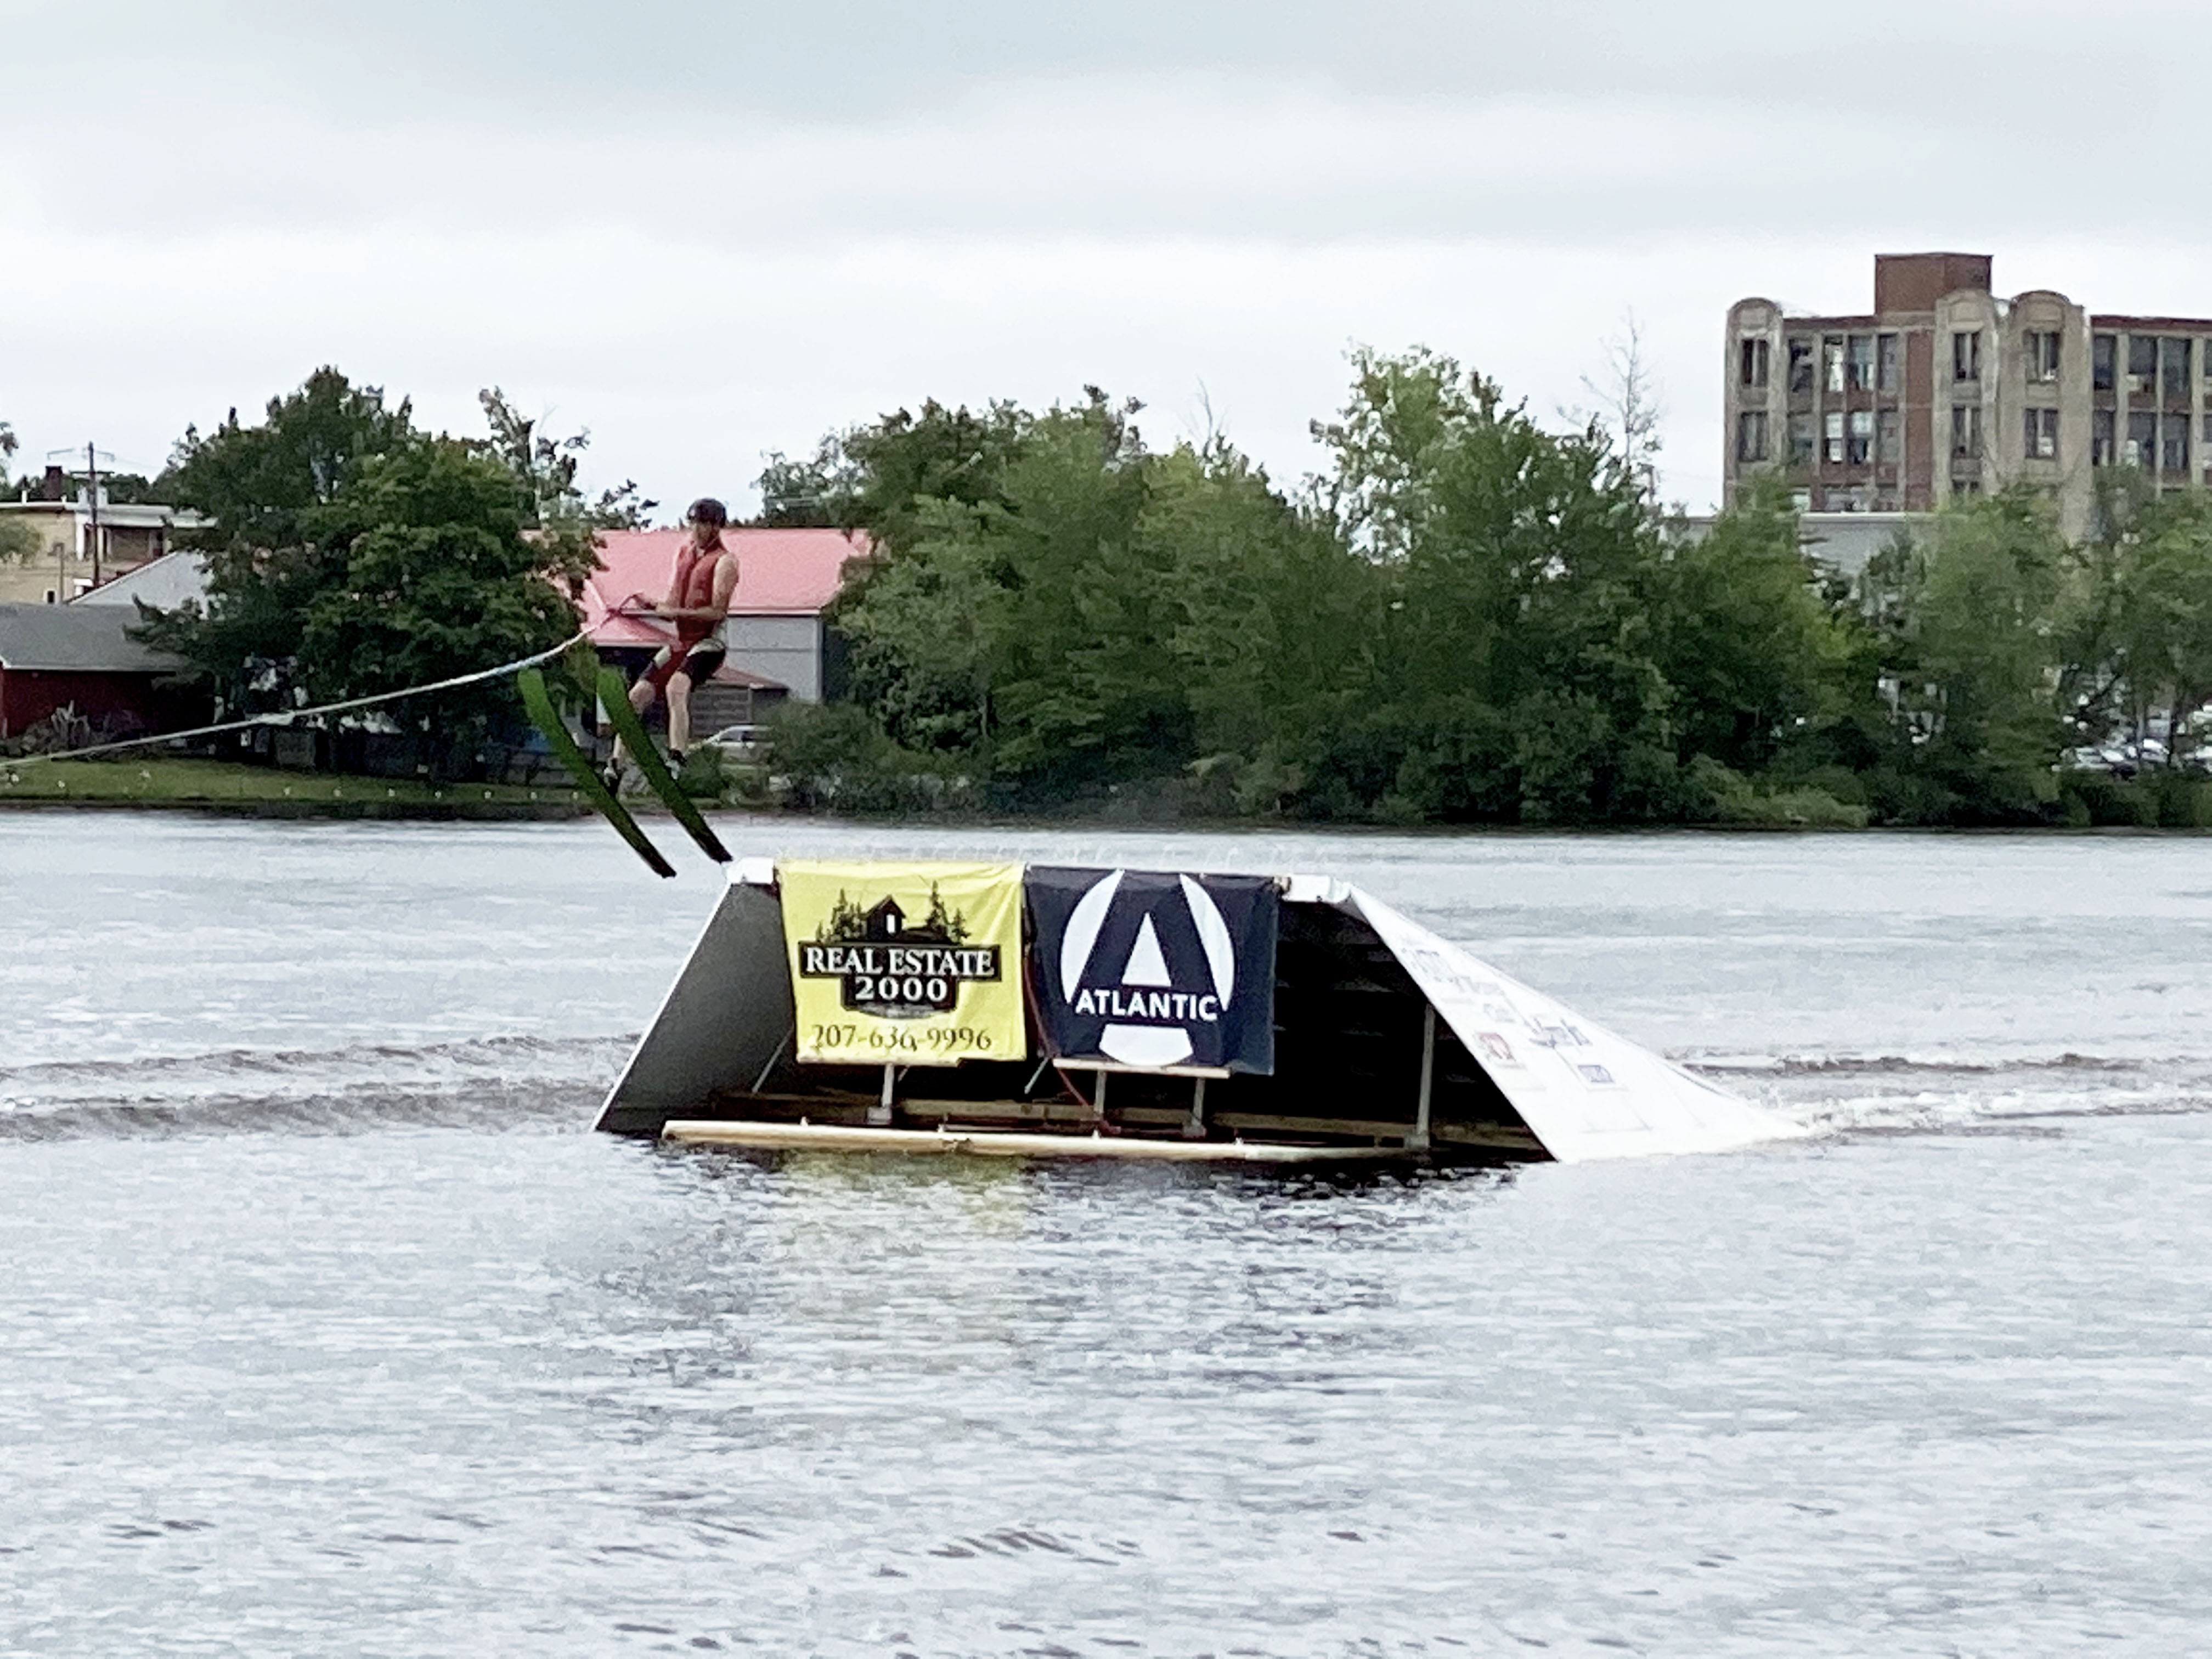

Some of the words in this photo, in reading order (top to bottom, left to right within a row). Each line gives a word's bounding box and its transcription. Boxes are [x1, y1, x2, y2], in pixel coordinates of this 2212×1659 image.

[806, 947, 883, 974] REAL
[888, 948, 995, 976] ESTATE
[855, 976, 947, 1001] 2000
[1075, 989, 1217, 1022] ATLANTIC
